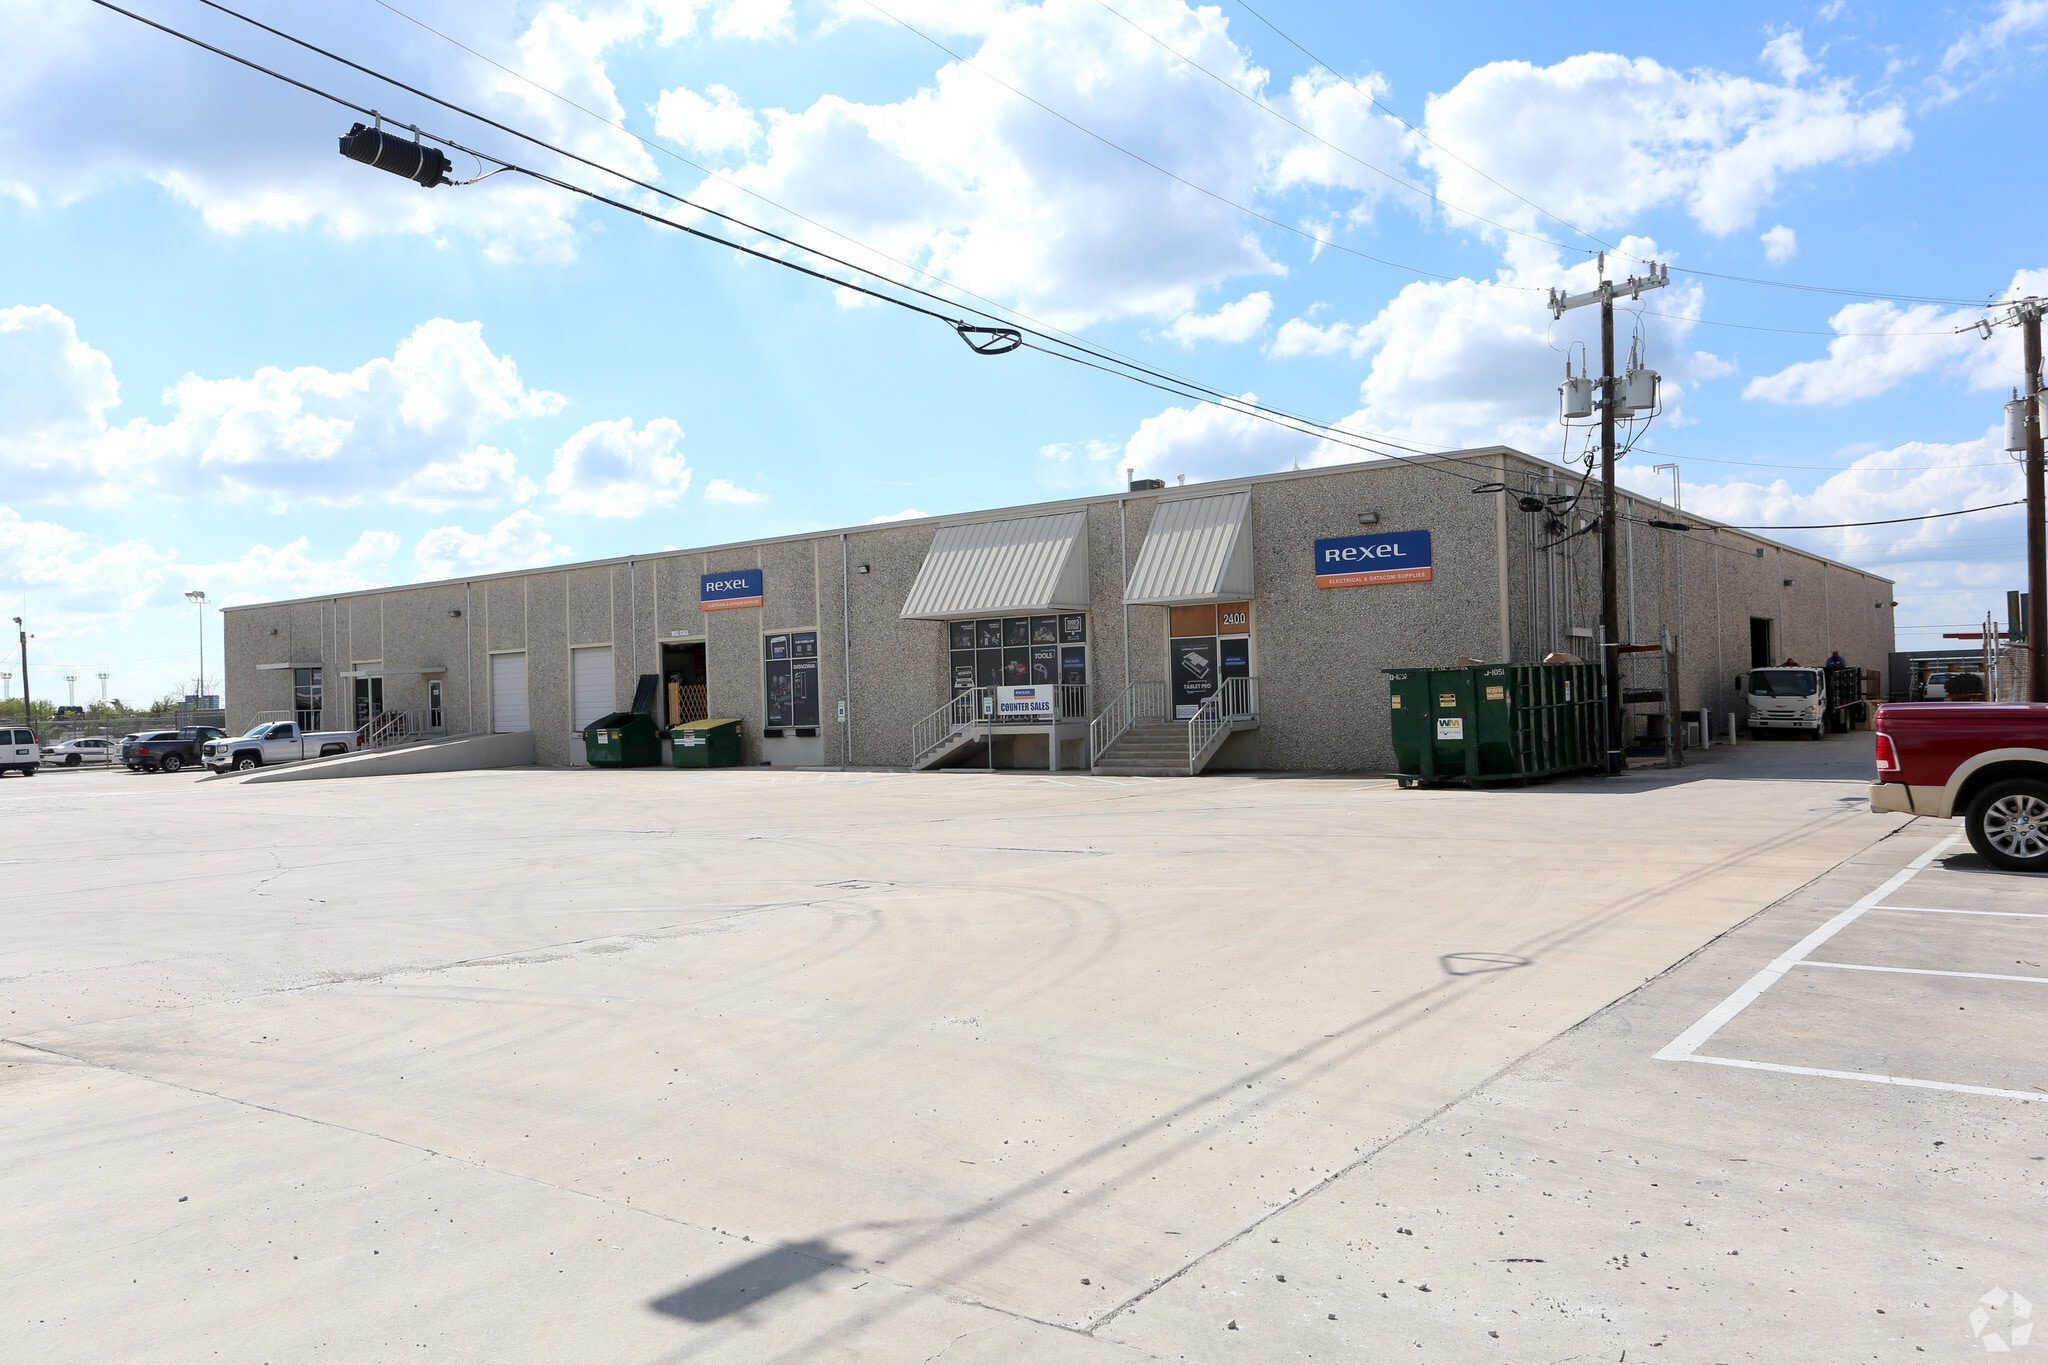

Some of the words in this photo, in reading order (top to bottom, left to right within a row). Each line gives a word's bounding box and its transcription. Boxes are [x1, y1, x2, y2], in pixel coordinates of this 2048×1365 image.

[1329, 577, 1362, 585] ELECTRICAL
[1223, 613, 1246, 625] 2400
[1034, 652, 1053, 660] TOOLS
[1000, 703, 1030, 712] COUNTER
[1031, 702, 1050, 711] SALES
